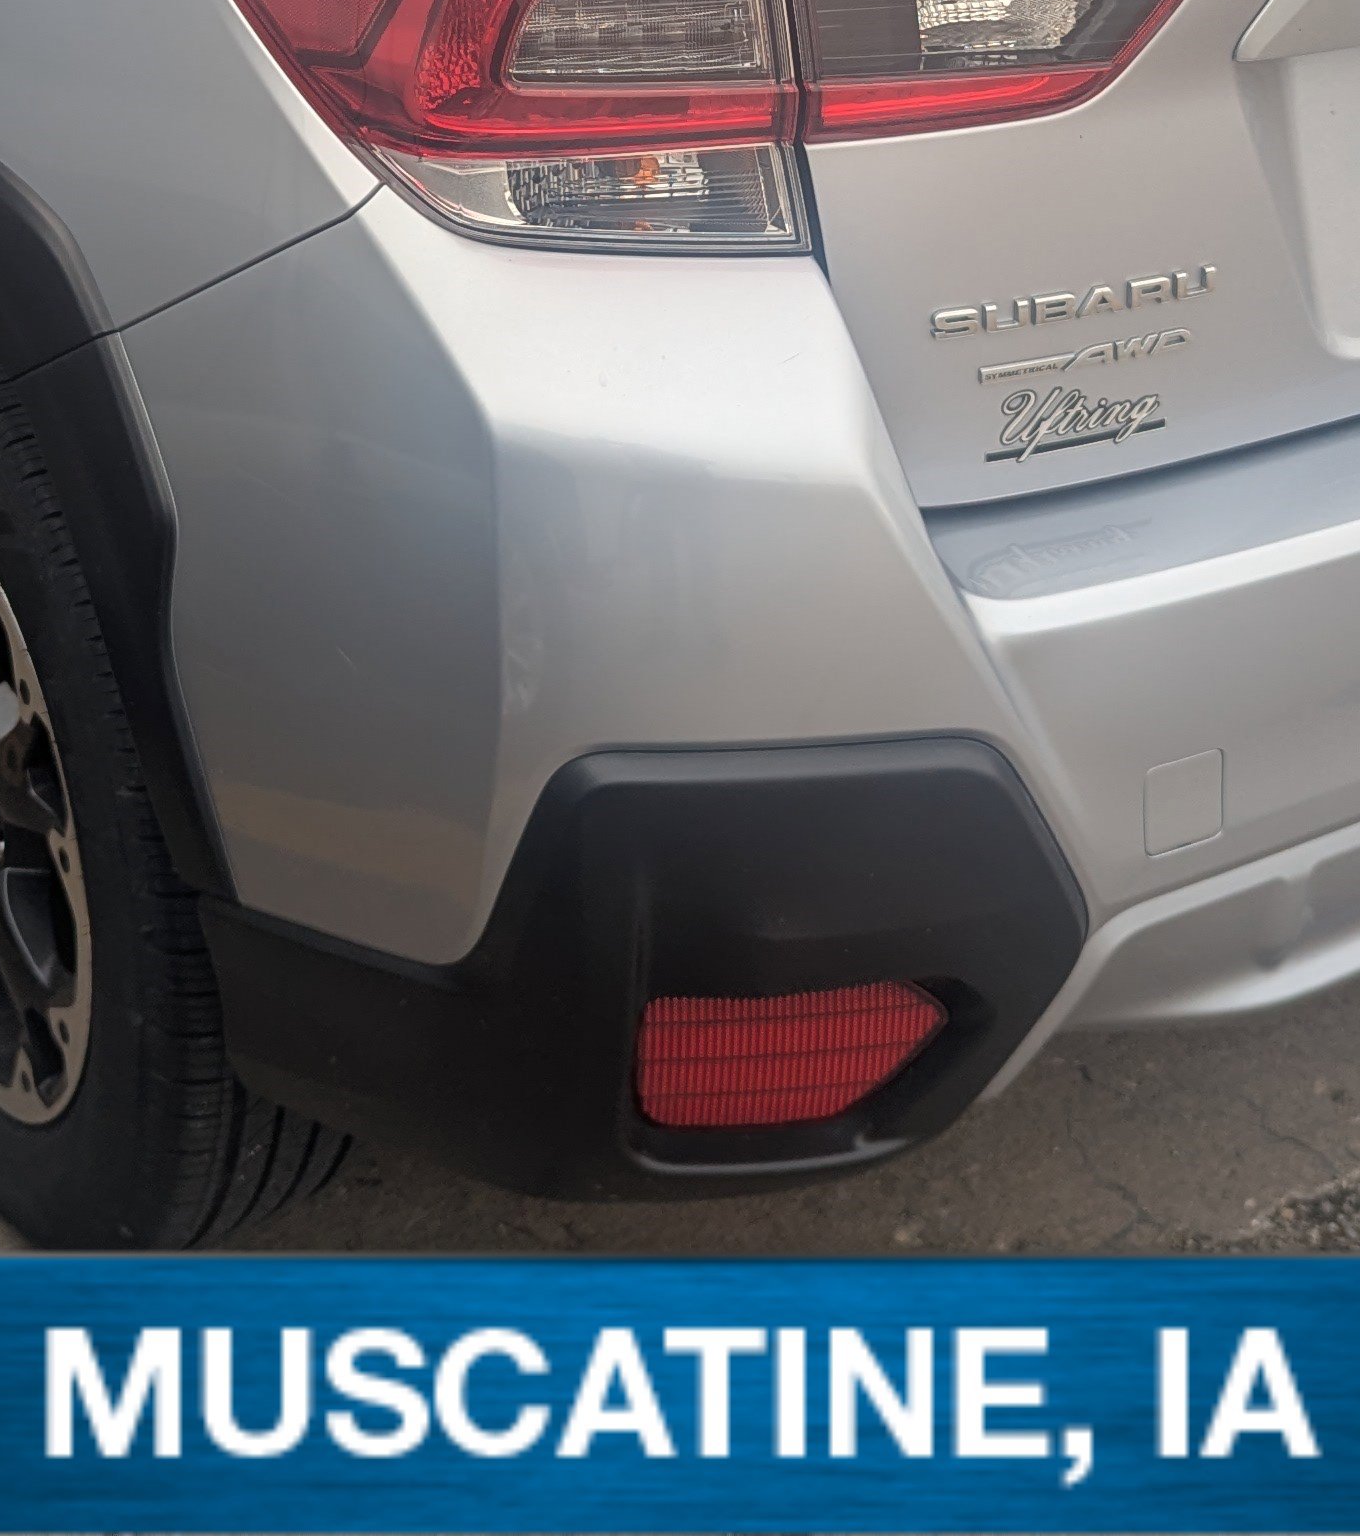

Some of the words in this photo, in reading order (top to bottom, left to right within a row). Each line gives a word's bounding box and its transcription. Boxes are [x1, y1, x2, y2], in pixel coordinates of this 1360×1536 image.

[930, 263, 1217, 340] SUBARU
[984, 363, 1058, 381] SYMMETRICAL
[1061, 327, 1193, 372] AWD
